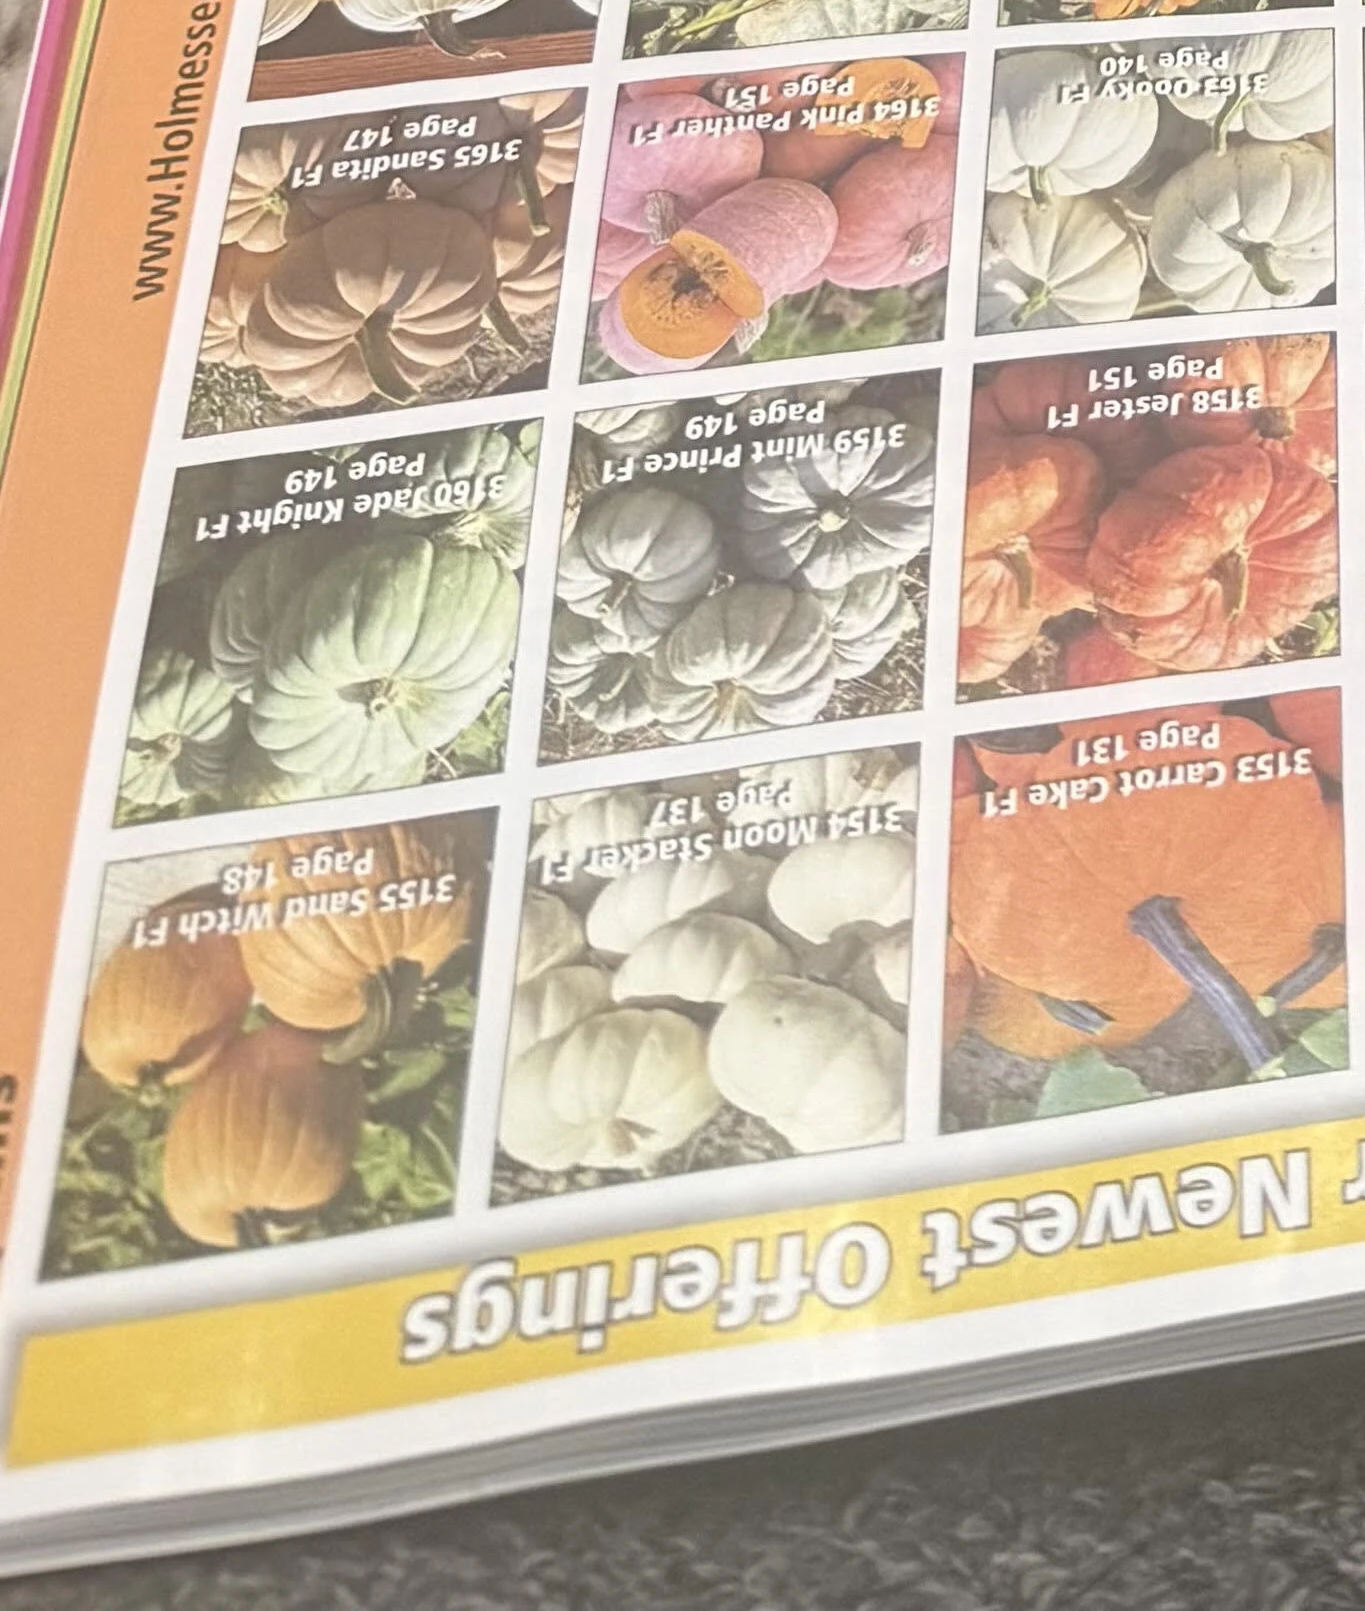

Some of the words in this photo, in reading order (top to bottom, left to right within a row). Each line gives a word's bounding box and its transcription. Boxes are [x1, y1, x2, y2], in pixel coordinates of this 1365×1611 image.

[285, 466, 337, 494] 149
[348, 452, 426, 480] Page
[354, 485, 428, 517] Jade
[434, 475, 506, 506] 3160
[196, 514, 229, 541] F1
[237, 498, 344, 534] Knight
[1077, 735, 1128, 767] 131
[1140, 721, 1220, 751] Page
[1120, 761, 1226, 797] Carrot
[1238, 748, 1312, 783] 3153
[984, 789, 1017, 818] F1
[1029, 777, 1110, 809] Cake
[222, 862, 278, 895] 148
[292, 846, 374, 879] Page
[284, 888, 369, 928] Sand
[380, 873, 456, 912] 3155
[133, 917, 168, 949] F1
[179, 903, 272, 943] Witch
[922, 1153, 1310, 1287] Newest
[400, 1223, 892, 1365] Offerings
